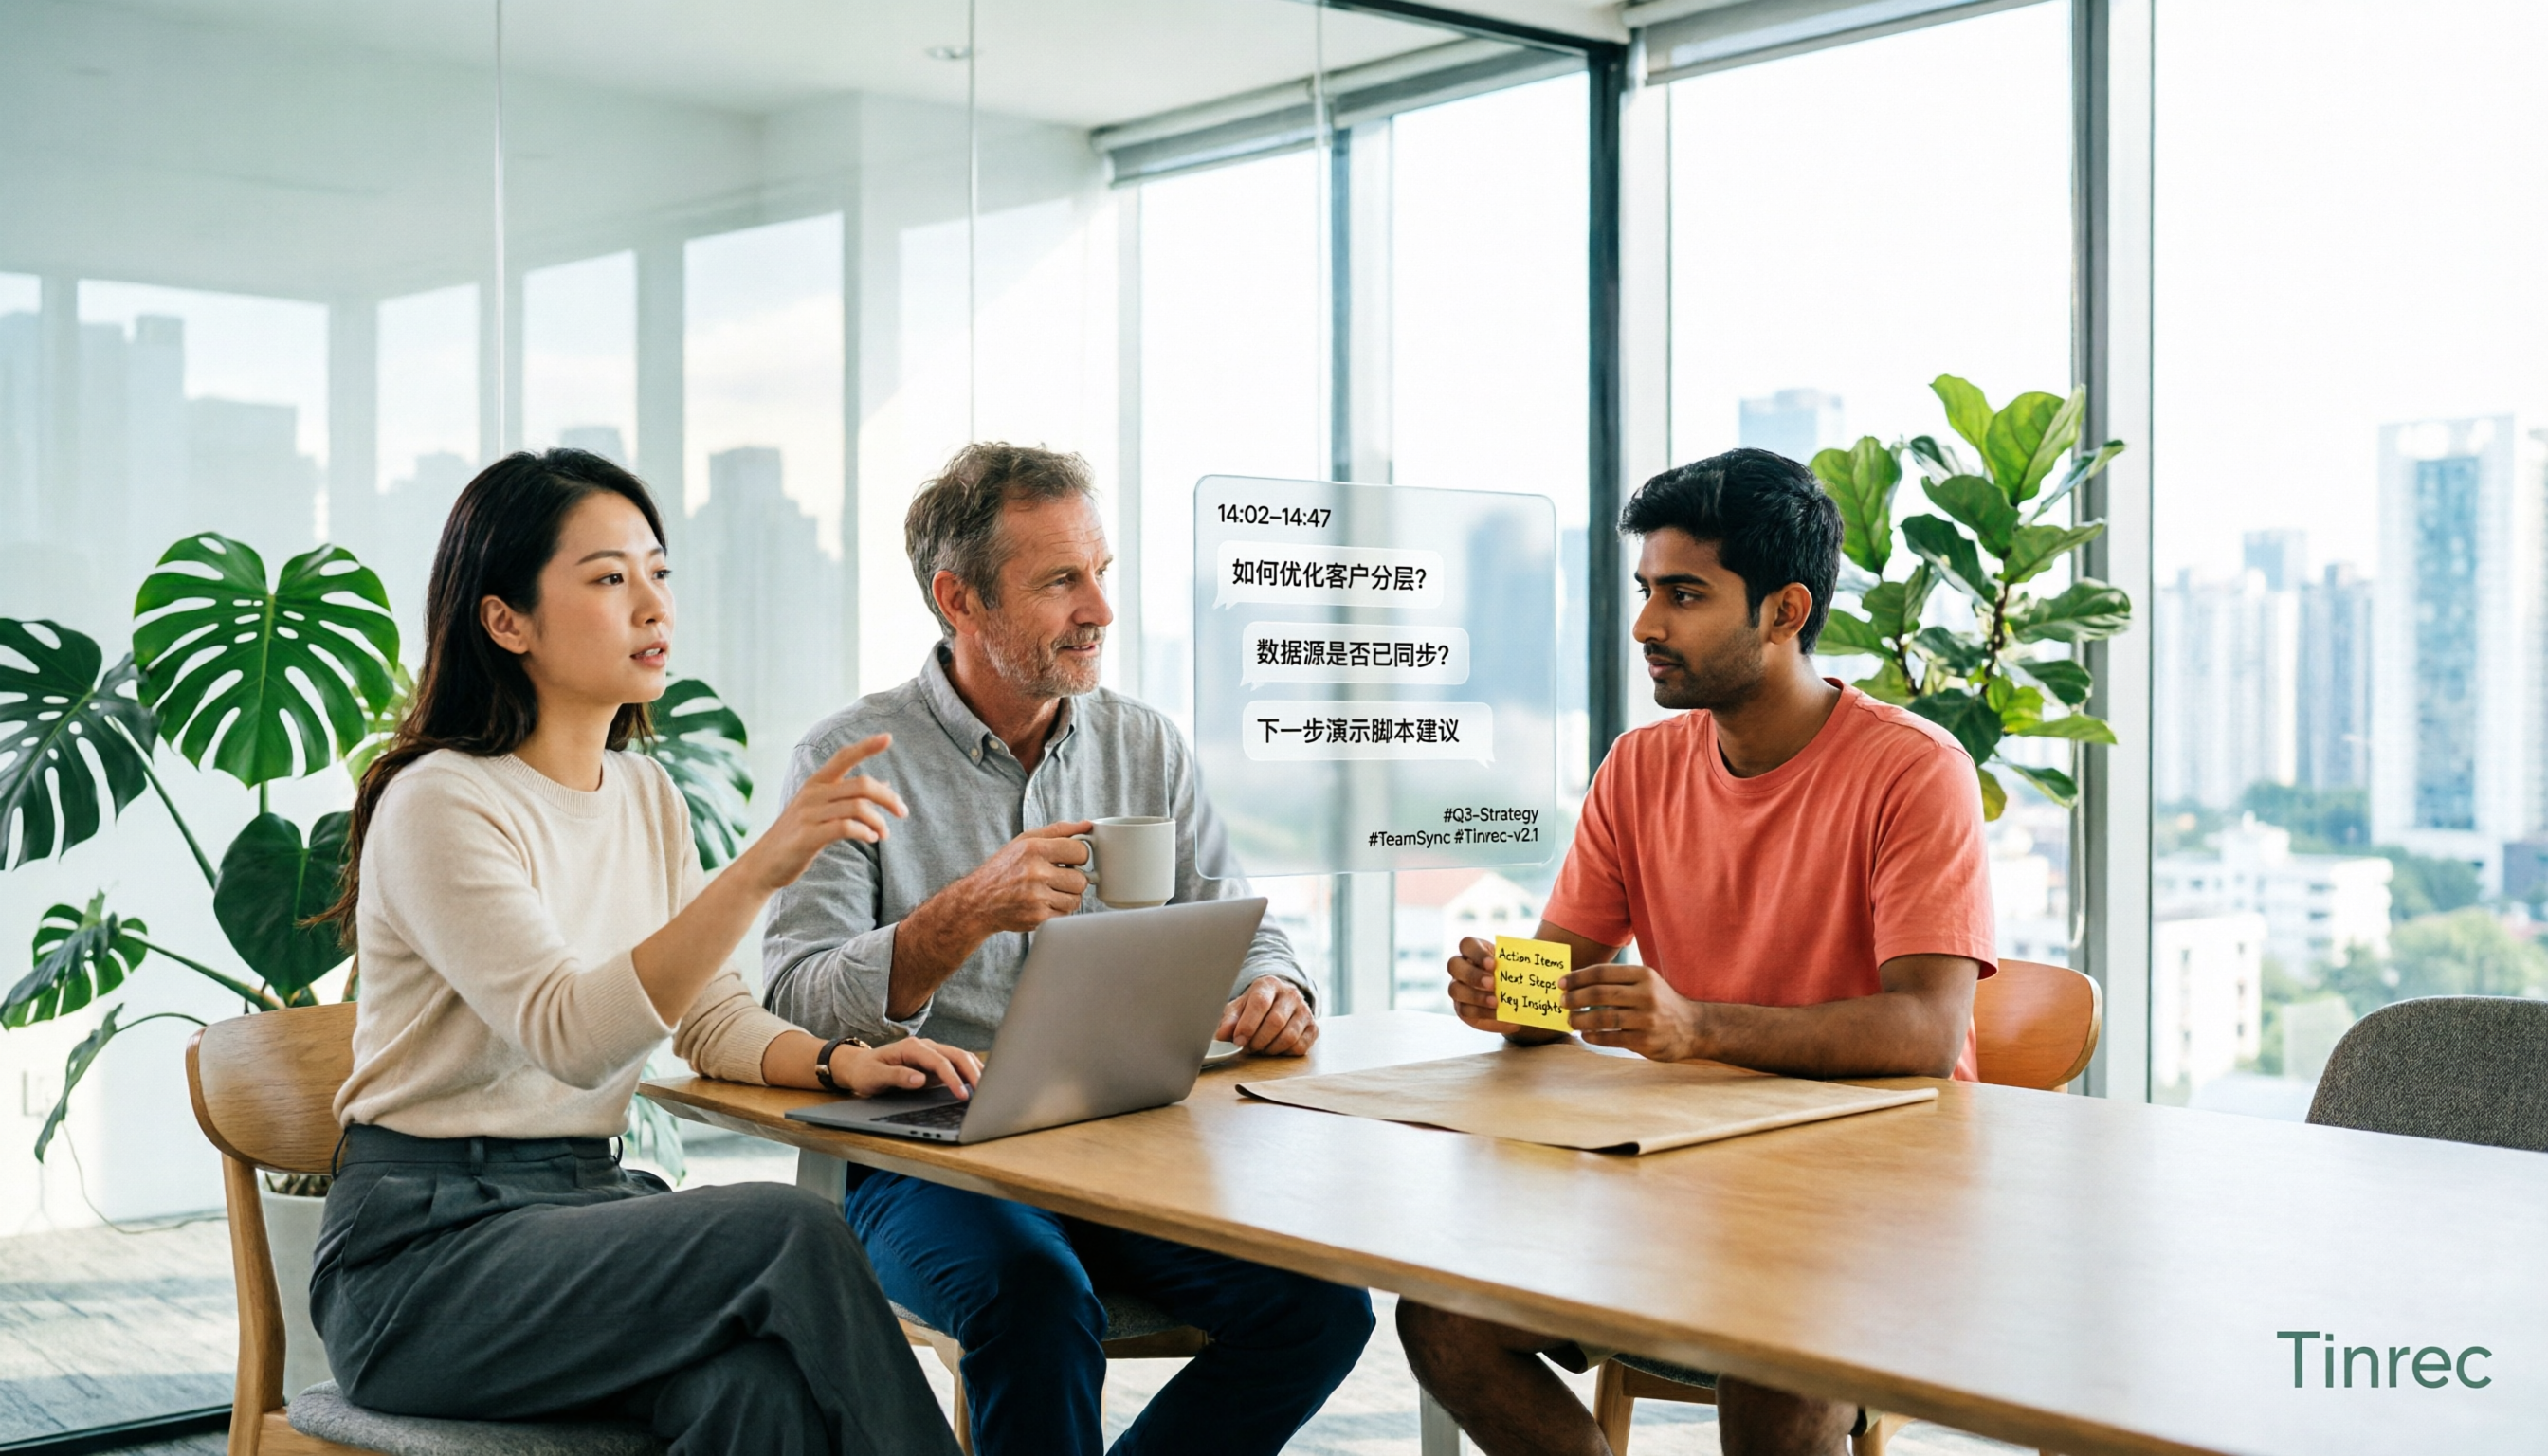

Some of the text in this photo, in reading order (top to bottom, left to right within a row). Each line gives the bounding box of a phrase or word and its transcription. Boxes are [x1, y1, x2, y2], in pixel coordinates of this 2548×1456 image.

[1232, 558, 1427, 591] 如何优化客户分层?
[1257, 638, 1449, 668] 数据源是否已同步?
[1257, 717, 1460, 744] 下一步演示脚本建议
[1443, 807, 1539, 825] #Q3-Strategy
[1368, 828, 1538, 849] #TeamSync #Tinrec-v2.1
[1499, 947, 1564, 969] Action Items
[1501, 970, 1556, 994] Next Steps
[1501, 991, 1562, 1016] Key Insights
